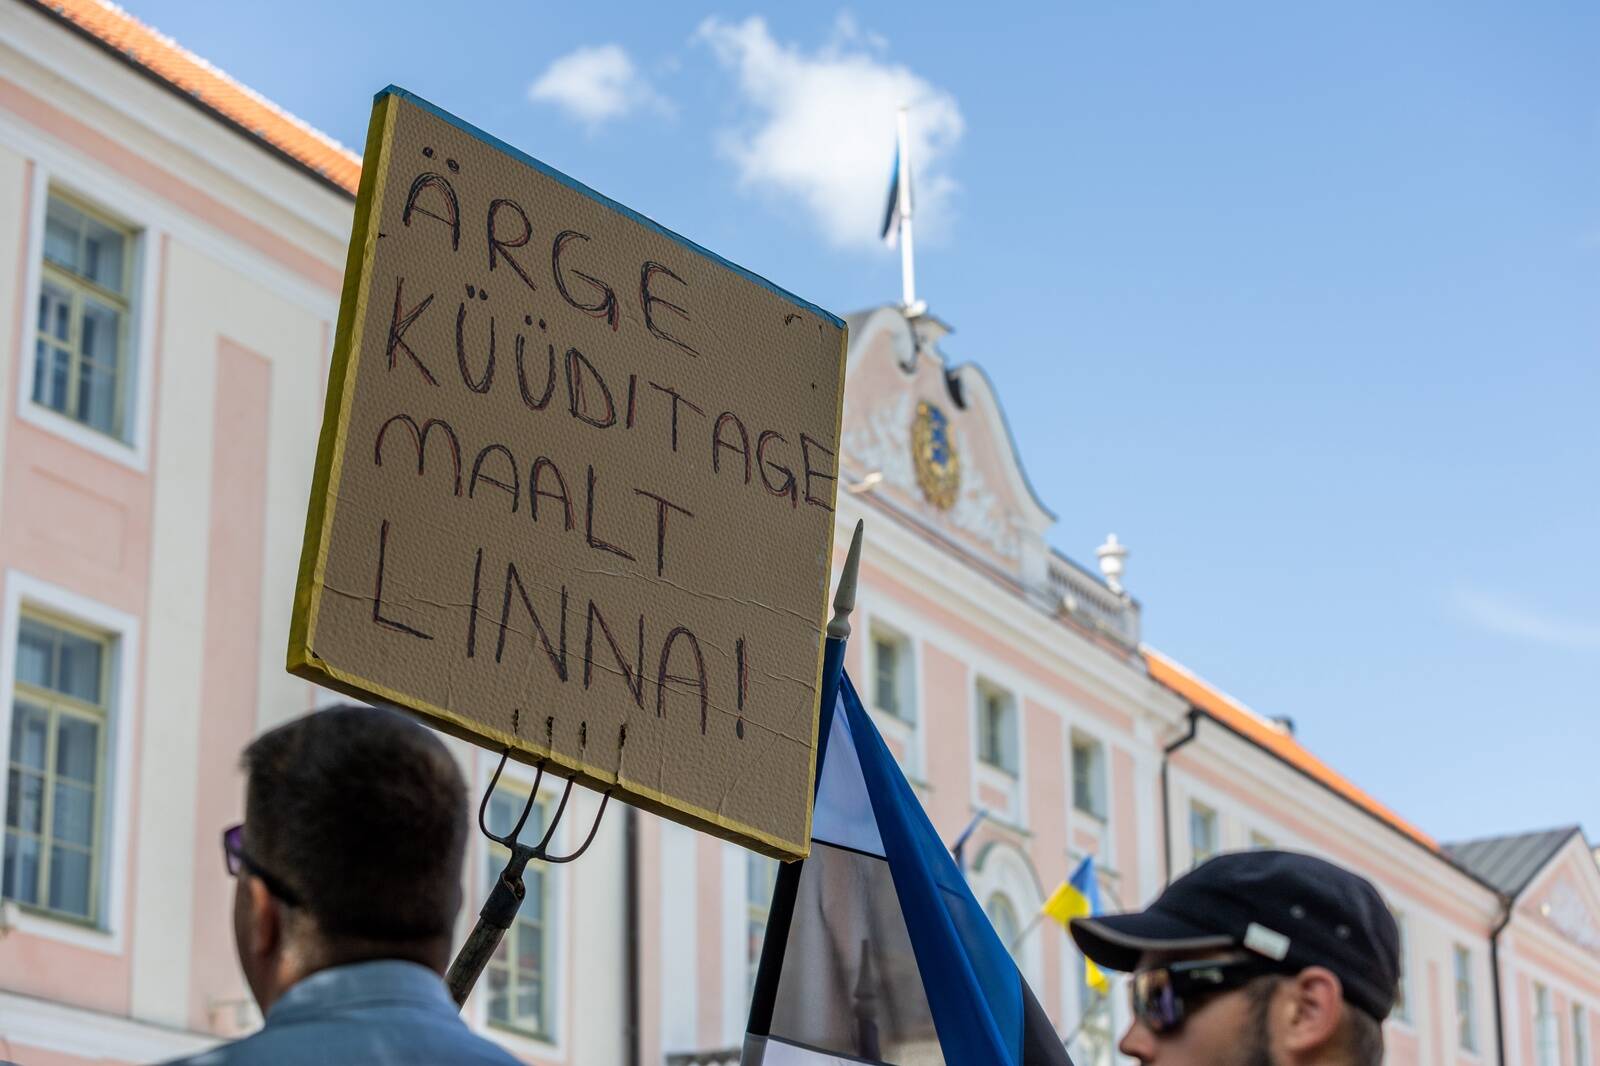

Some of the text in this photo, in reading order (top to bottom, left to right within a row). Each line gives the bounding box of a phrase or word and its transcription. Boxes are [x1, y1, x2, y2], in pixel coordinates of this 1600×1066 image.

[403, 147, 700, 357] ÄRGE
[375, 414, 693, 577] MAALT
[387, 277, 836, 512] KÜÜDITAGE
[373, 519, 748, 740] LINNA!
